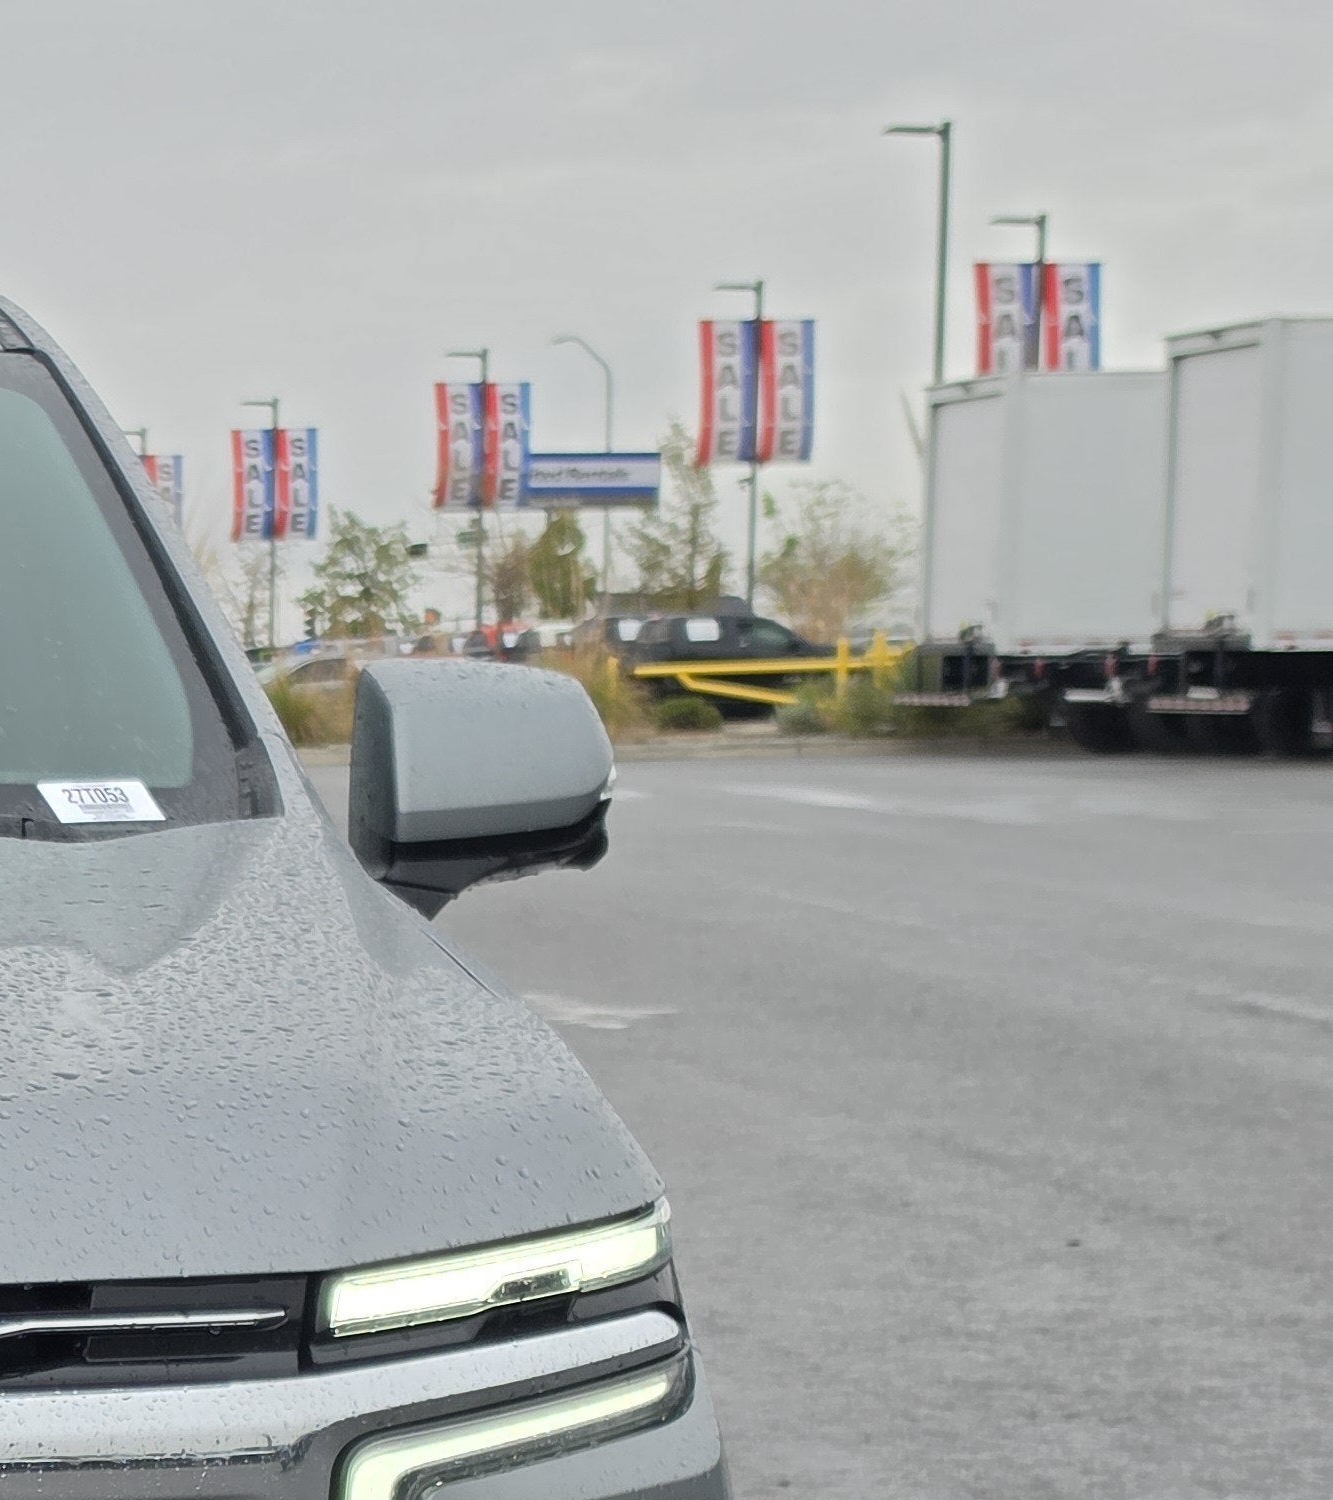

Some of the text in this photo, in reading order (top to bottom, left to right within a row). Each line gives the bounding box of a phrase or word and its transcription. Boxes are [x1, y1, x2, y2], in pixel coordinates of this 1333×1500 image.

[716, 331, 739, 455] SALE
[778, 331, 800, 454] SALE
[244, 438, 262, 534] SALE
[290, 437, 308, 533] SALE
[450, 393, 469, 500] SALE
[500, 393, 519, 500] SALE
[62, 787, 129, 804] 27T053
